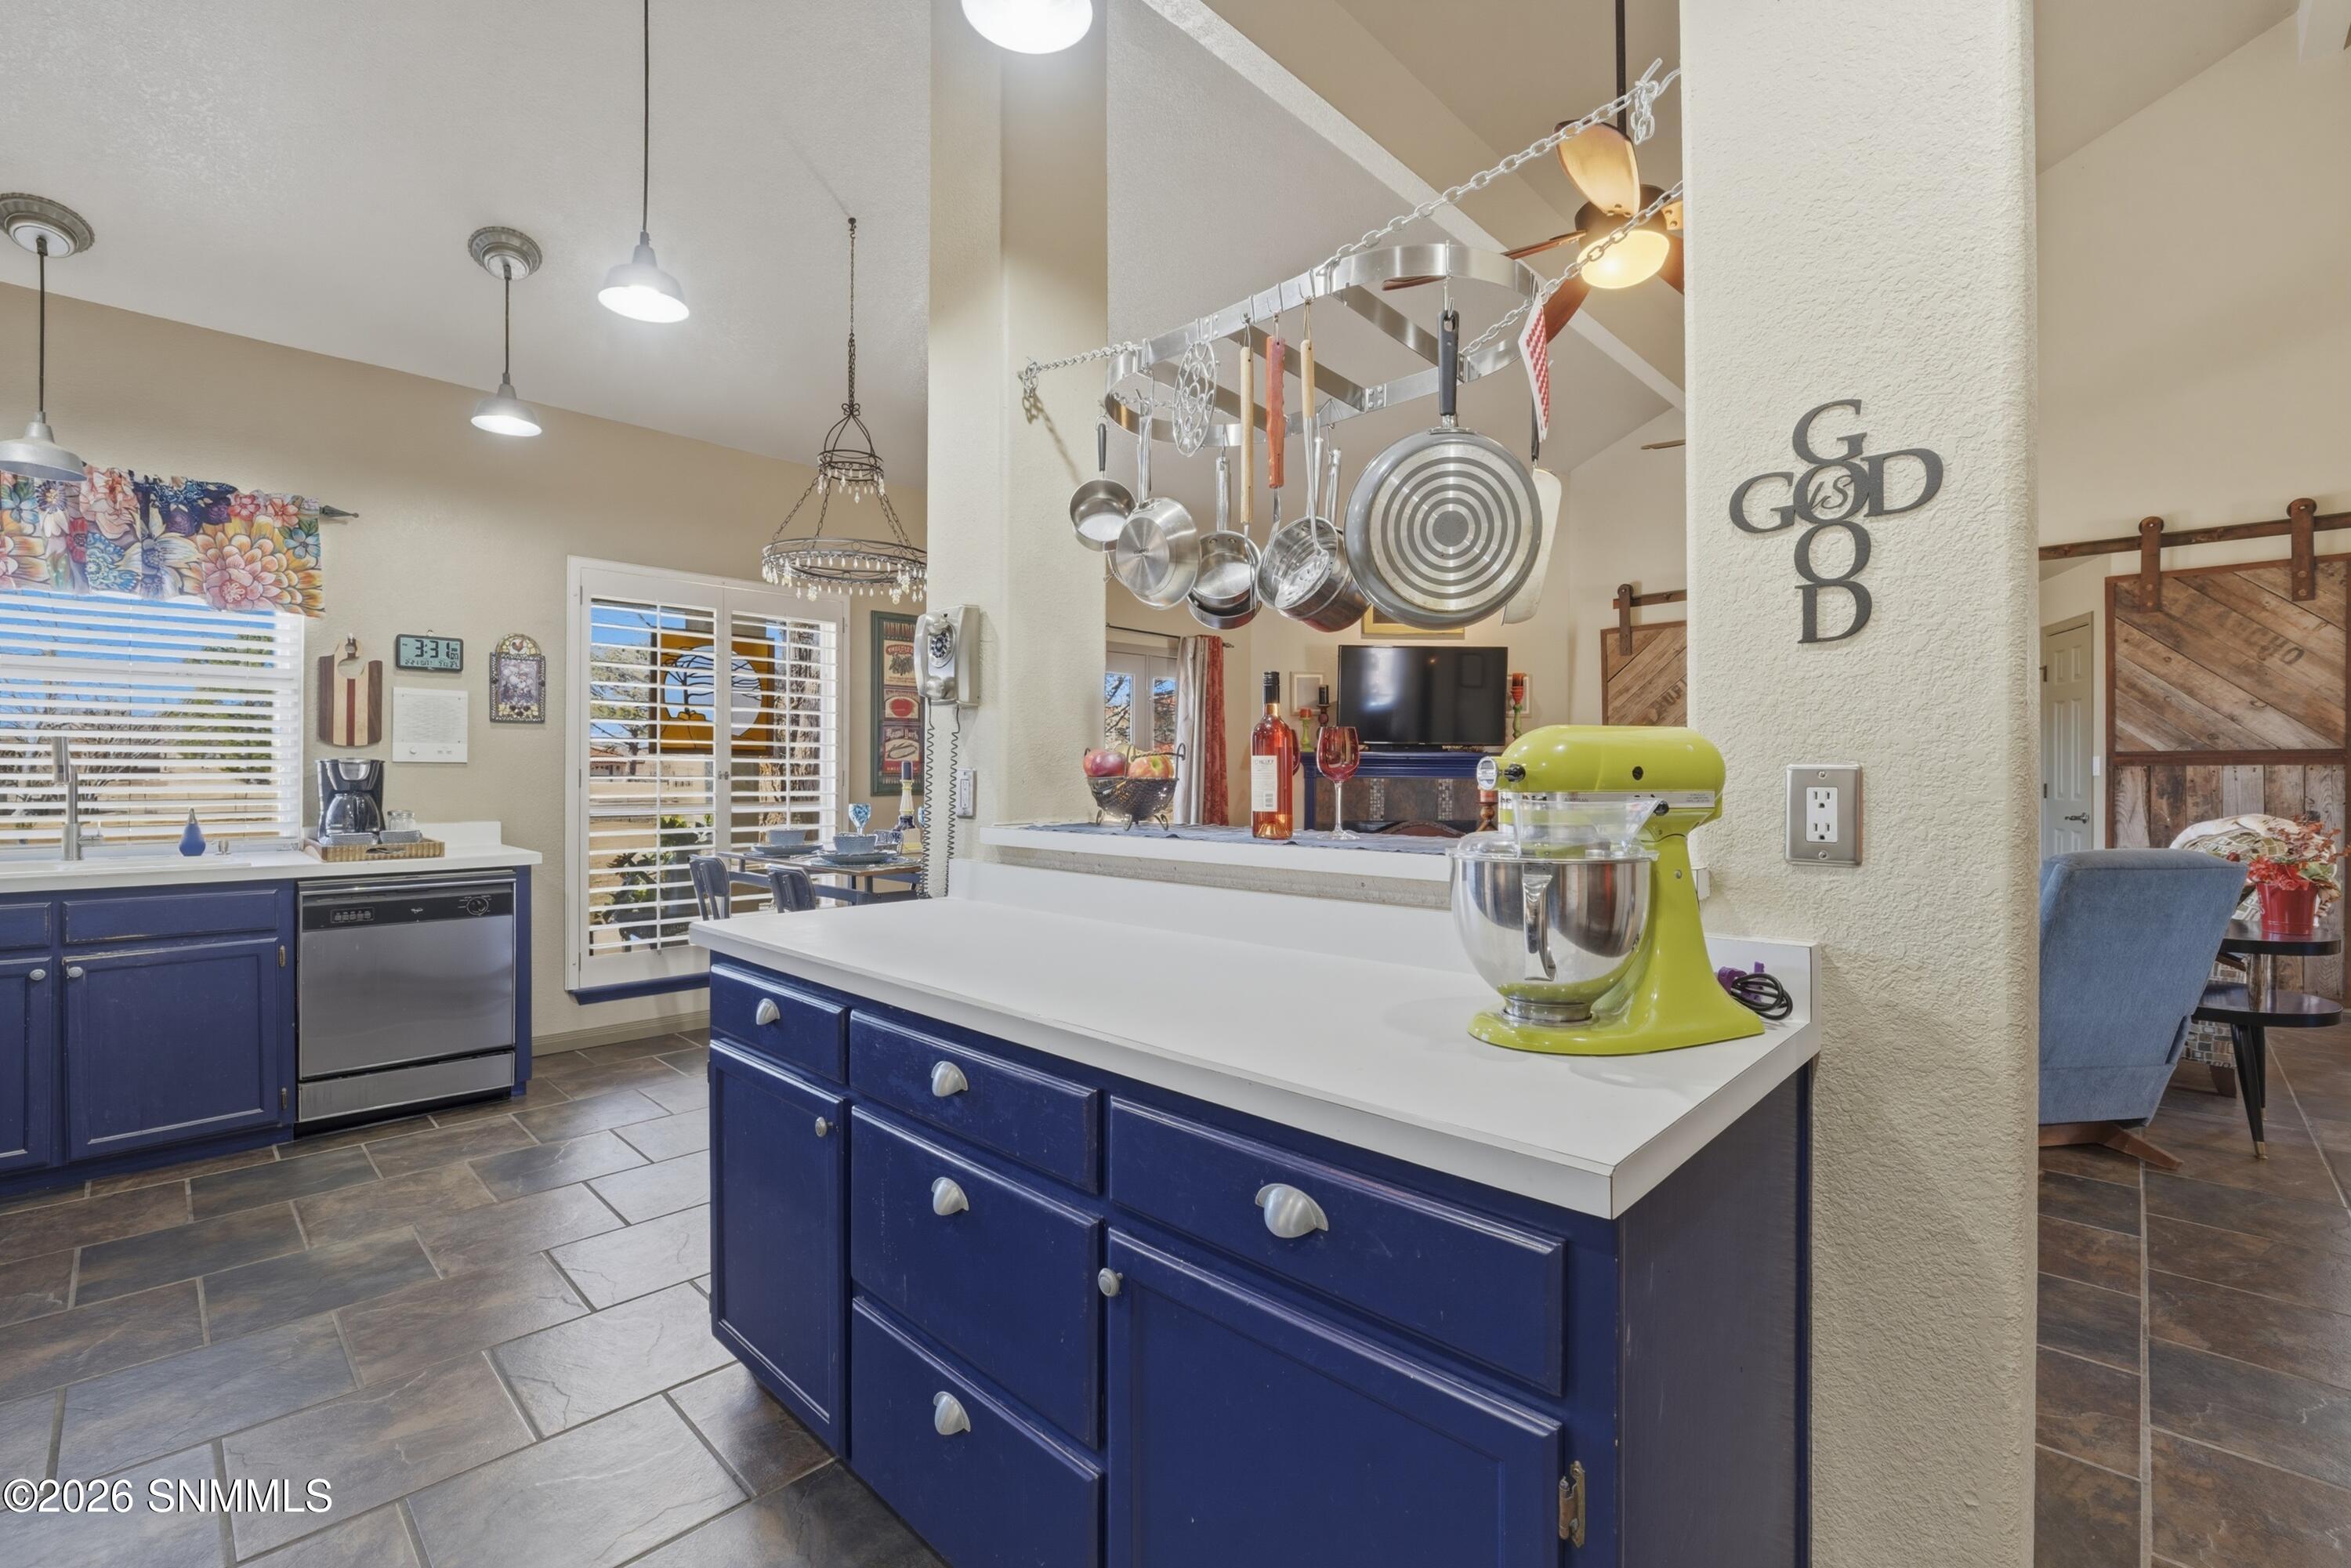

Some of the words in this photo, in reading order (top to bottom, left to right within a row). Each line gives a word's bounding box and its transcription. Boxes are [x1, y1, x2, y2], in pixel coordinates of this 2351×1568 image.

[1729, 447, 1943, 534] GOD
[1791, 399, 1872, 644] GOOD
[415, 639, 450, 658] 3:31
